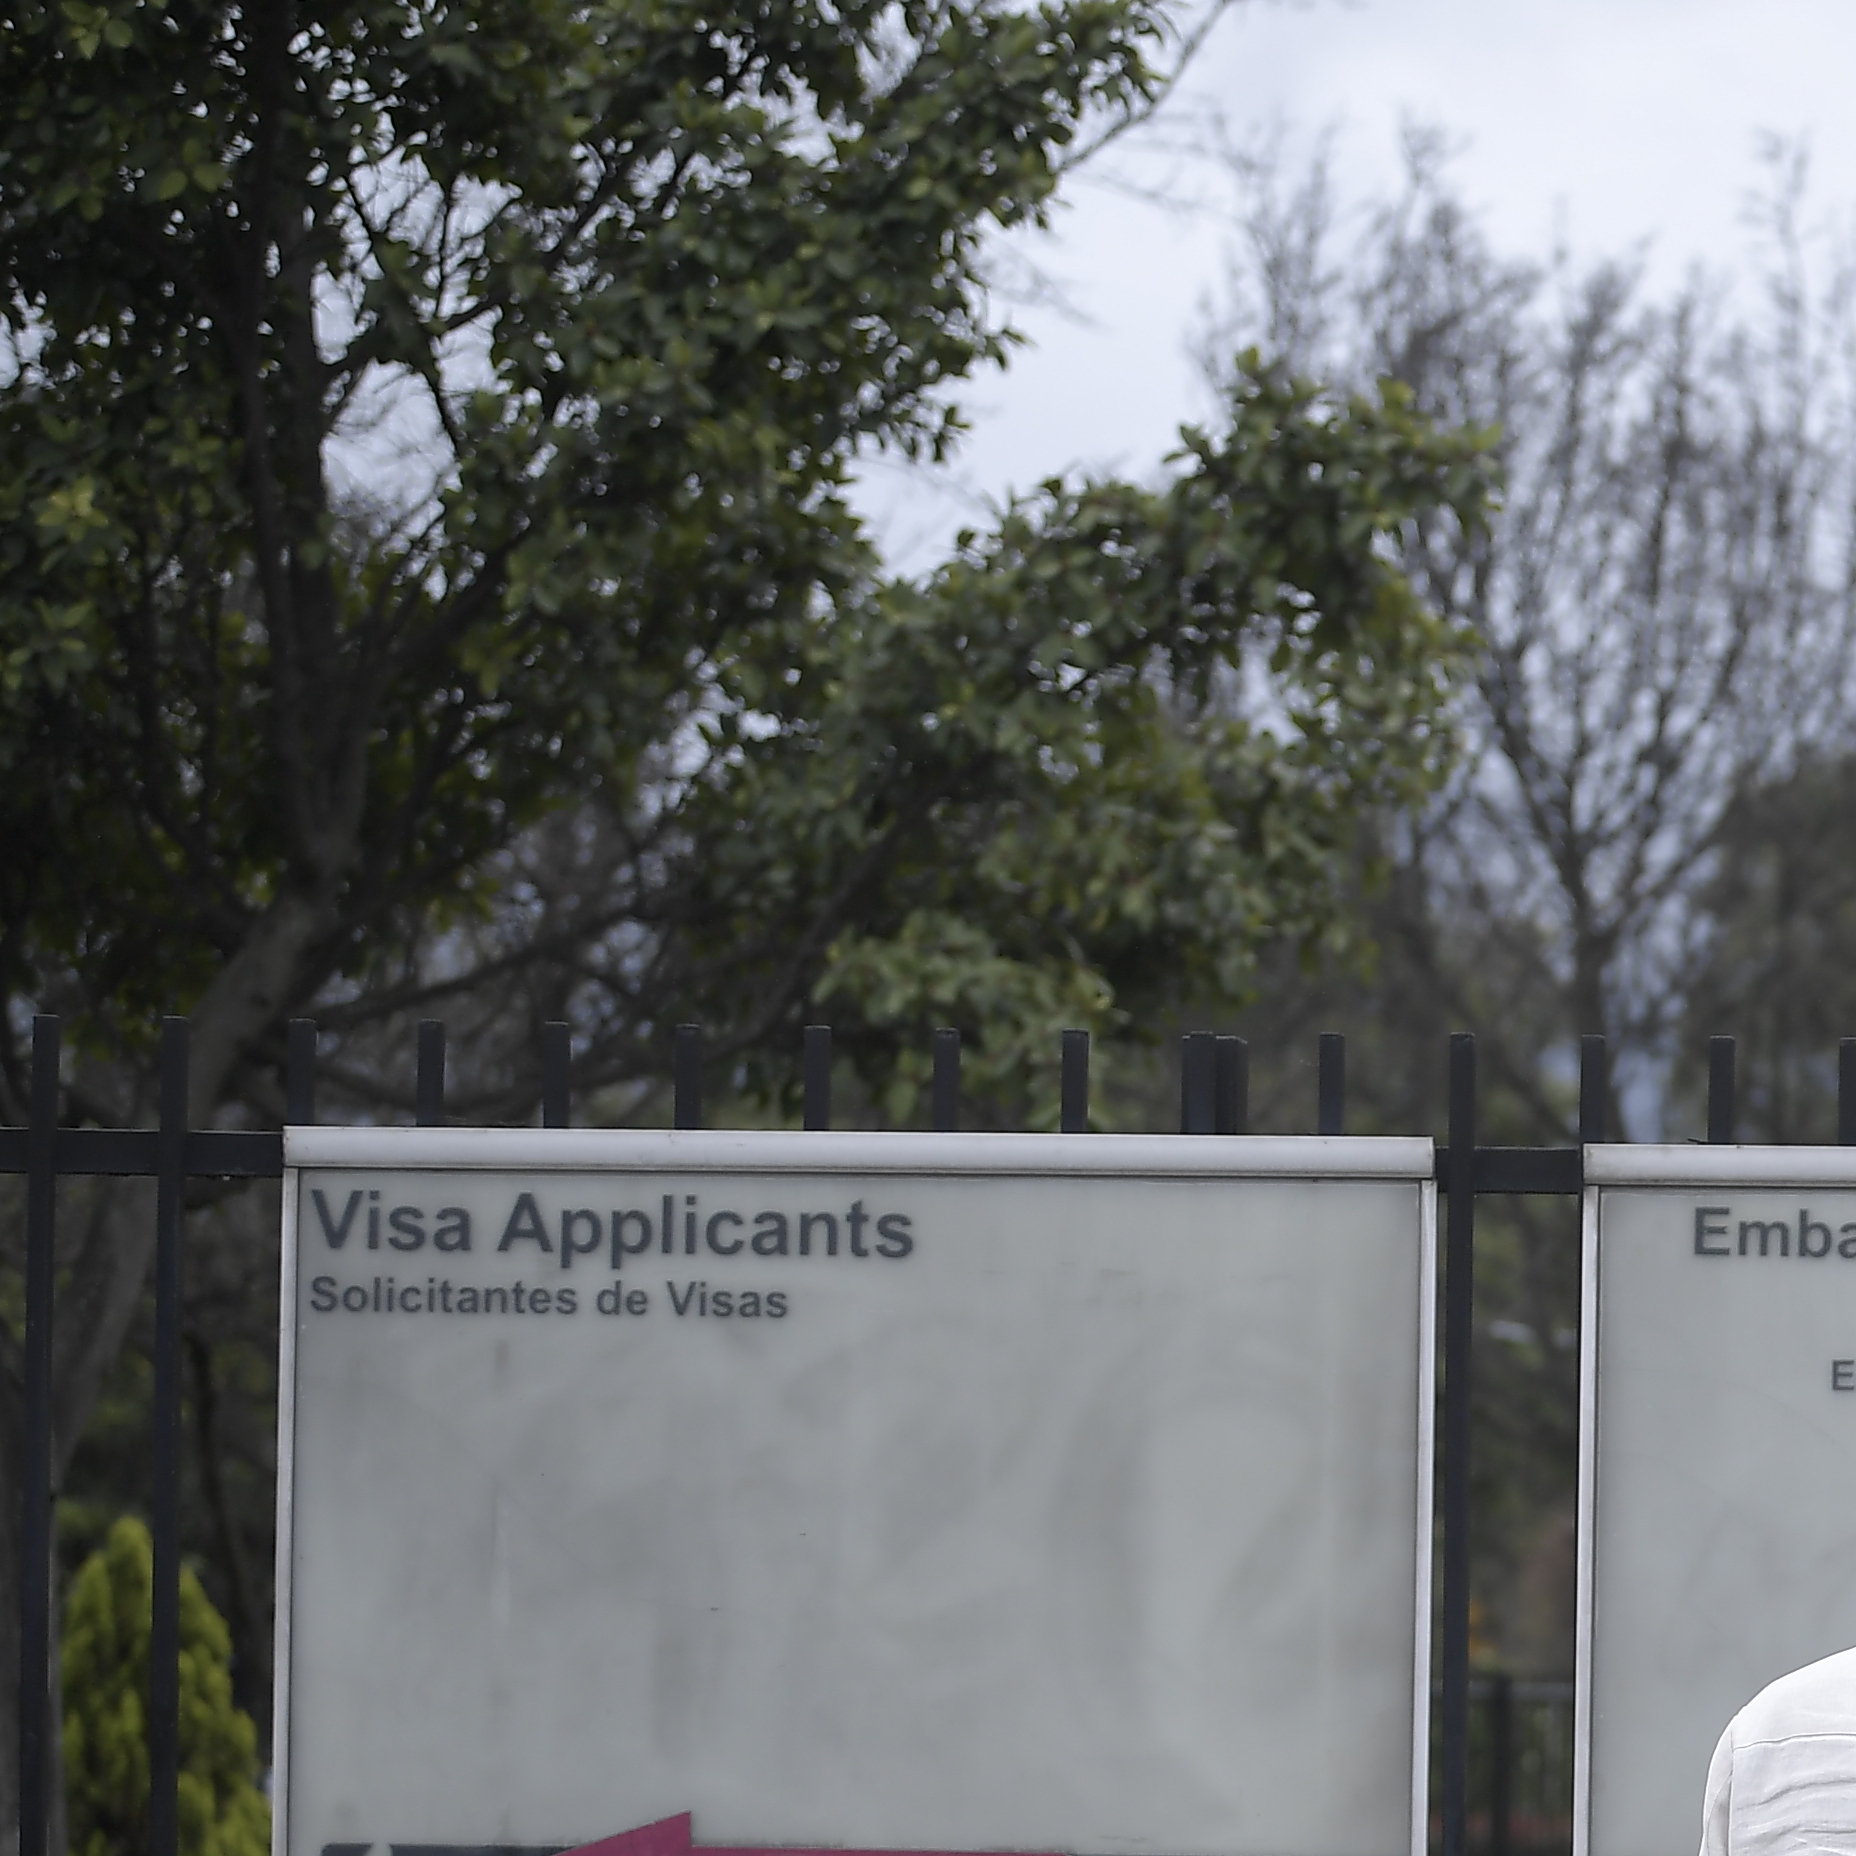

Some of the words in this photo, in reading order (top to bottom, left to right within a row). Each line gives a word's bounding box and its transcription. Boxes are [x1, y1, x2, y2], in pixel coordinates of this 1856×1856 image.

[307, 1187, 472, 1254] Visa
[496, 1190, 916, 1270] Applicants
[308, 1275, 578, 1316] Solicitantes
[595, 1279, 650, 1317] de
[666, 1280, 789, 1320] Visas
